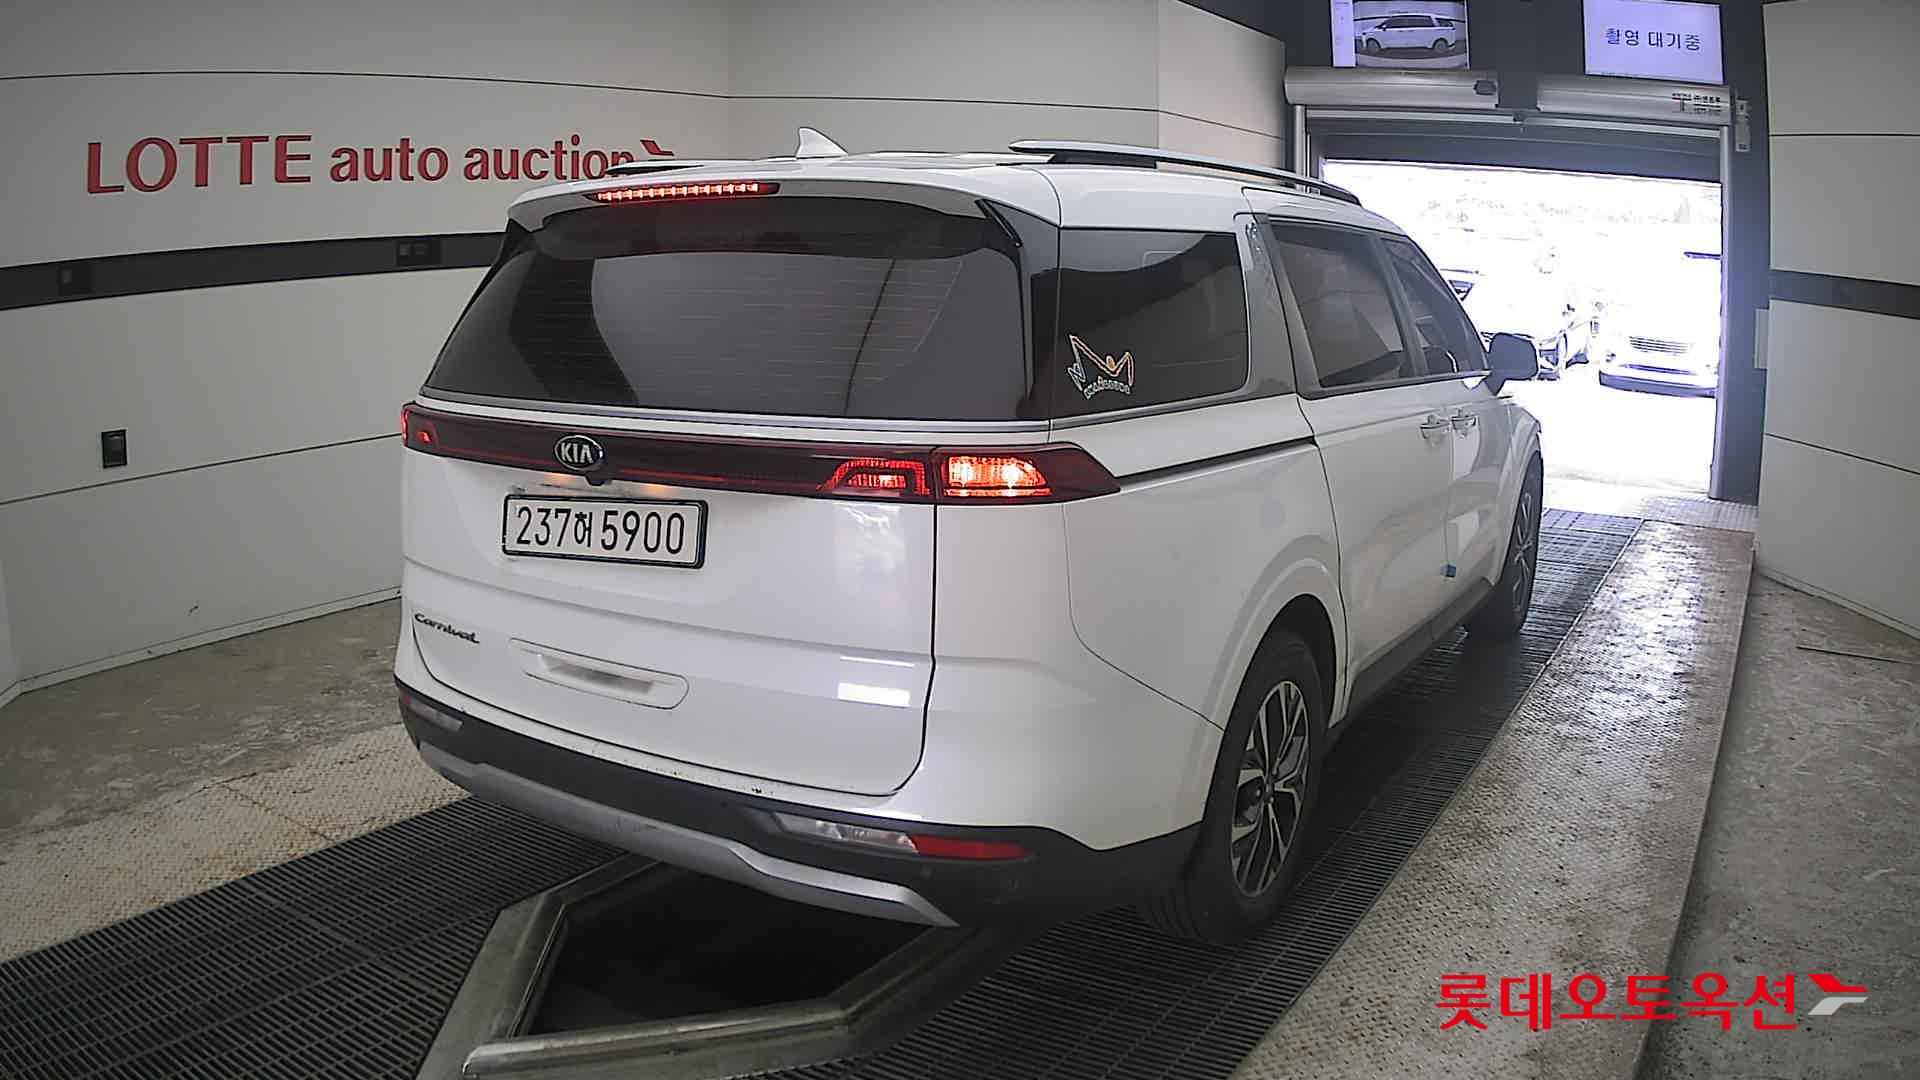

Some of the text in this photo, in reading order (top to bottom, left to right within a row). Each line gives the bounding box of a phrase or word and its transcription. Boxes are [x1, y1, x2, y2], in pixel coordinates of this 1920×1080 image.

[1647, 31, 1702, 52] 대기중
[87, 134, 634, 194] LOTTE auto auction
[560, 442, 595, 464] KIA
[600, 509, 686, 555] 5900
[413, 612, 482, 645] Carnival
